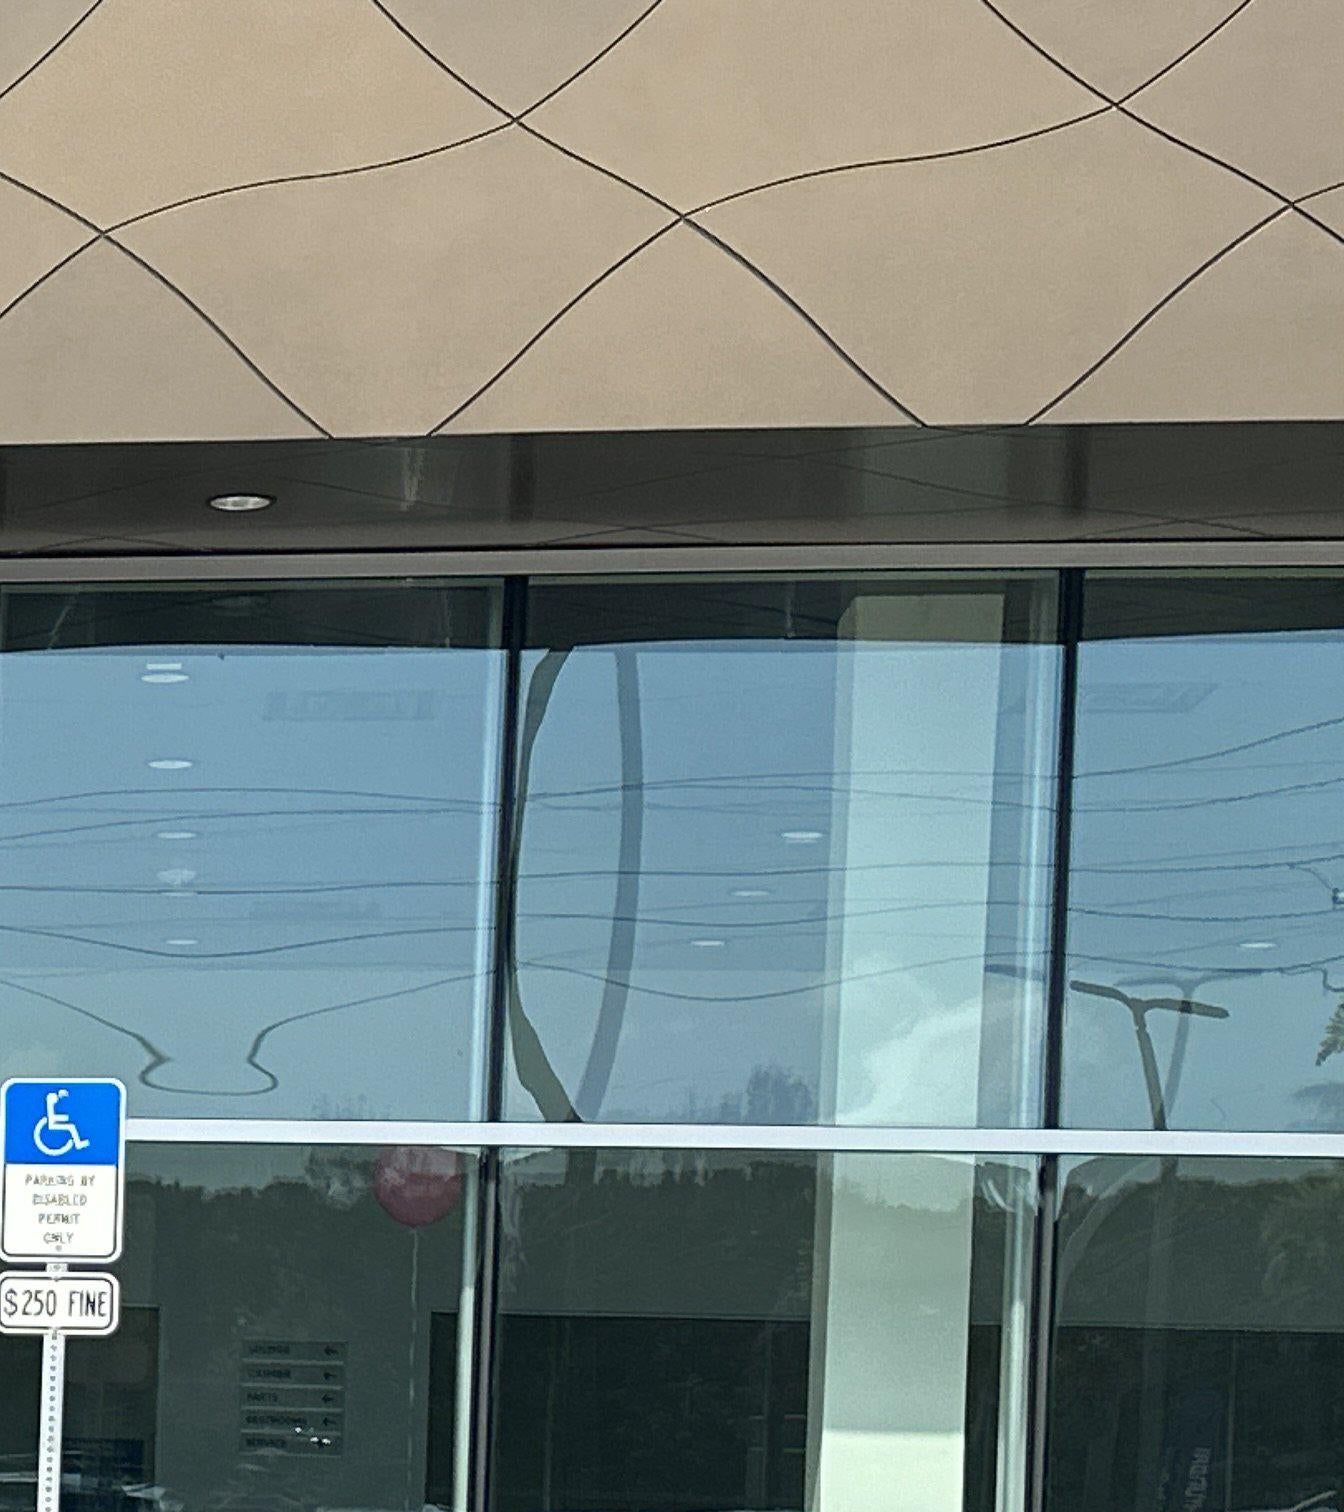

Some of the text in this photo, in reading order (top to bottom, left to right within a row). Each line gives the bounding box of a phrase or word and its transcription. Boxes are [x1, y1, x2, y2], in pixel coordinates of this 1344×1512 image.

[38, 1213, 81, 1224] PERMIT
[3, 1288, 109, 1318] $250 FINE
